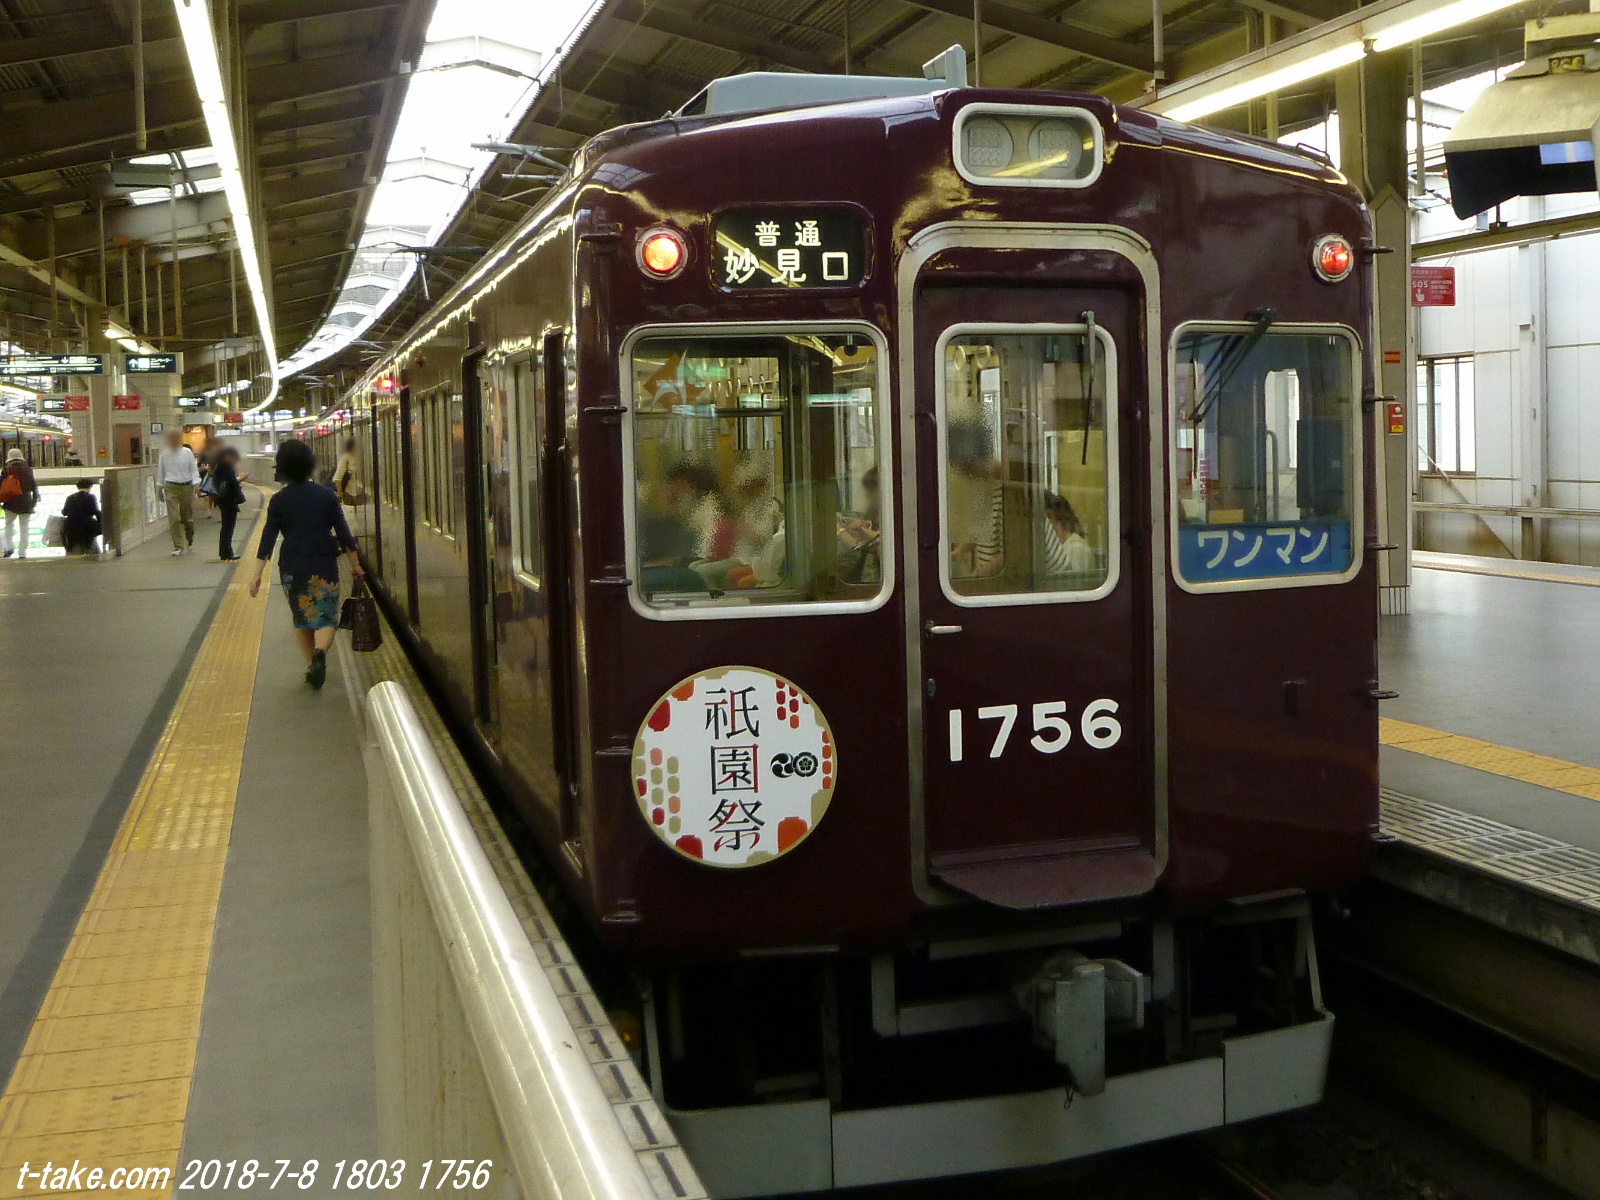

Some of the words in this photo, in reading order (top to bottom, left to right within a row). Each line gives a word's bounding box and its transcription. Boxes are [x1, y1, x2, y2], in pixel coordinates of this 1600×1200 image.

[755, 220, 821, 247] 普通
[724, 248, 849, 284] 妙見口
[1412, 280, 1428, 288] SOS
[1198, 527, 1328, 569] ワンマン
[949, 698, 1122, 762] 1756
[705, 686, 765, 852] 祇園祭
